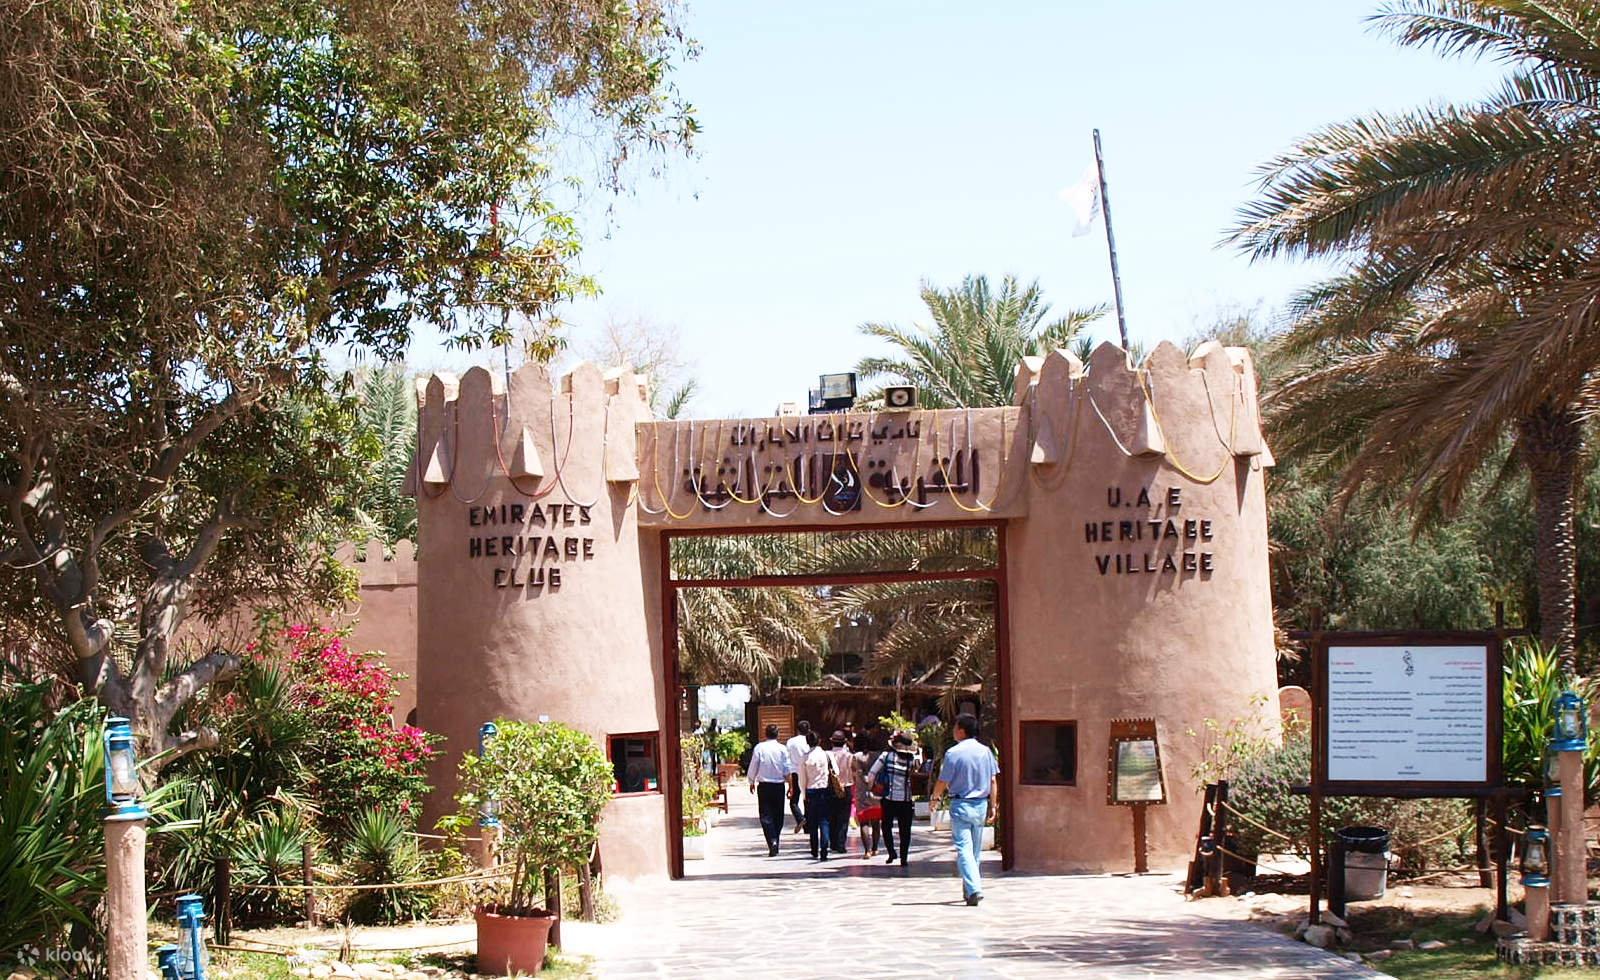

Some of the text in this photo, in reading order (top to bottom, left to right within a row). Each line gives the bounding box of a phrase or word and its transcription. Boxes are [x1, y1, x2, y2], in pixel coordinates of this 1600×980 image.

[868, 449, 980, 512] القرية
[469, 503, 592, 526] EMIRATES
[1085, 519, 1213, 543] HERITAGE
[469, 536, 595, 558] HERITAGE
[1095, 552, 1213, 575] VILLAGE
[494, 567, 561, 588] CLUB
